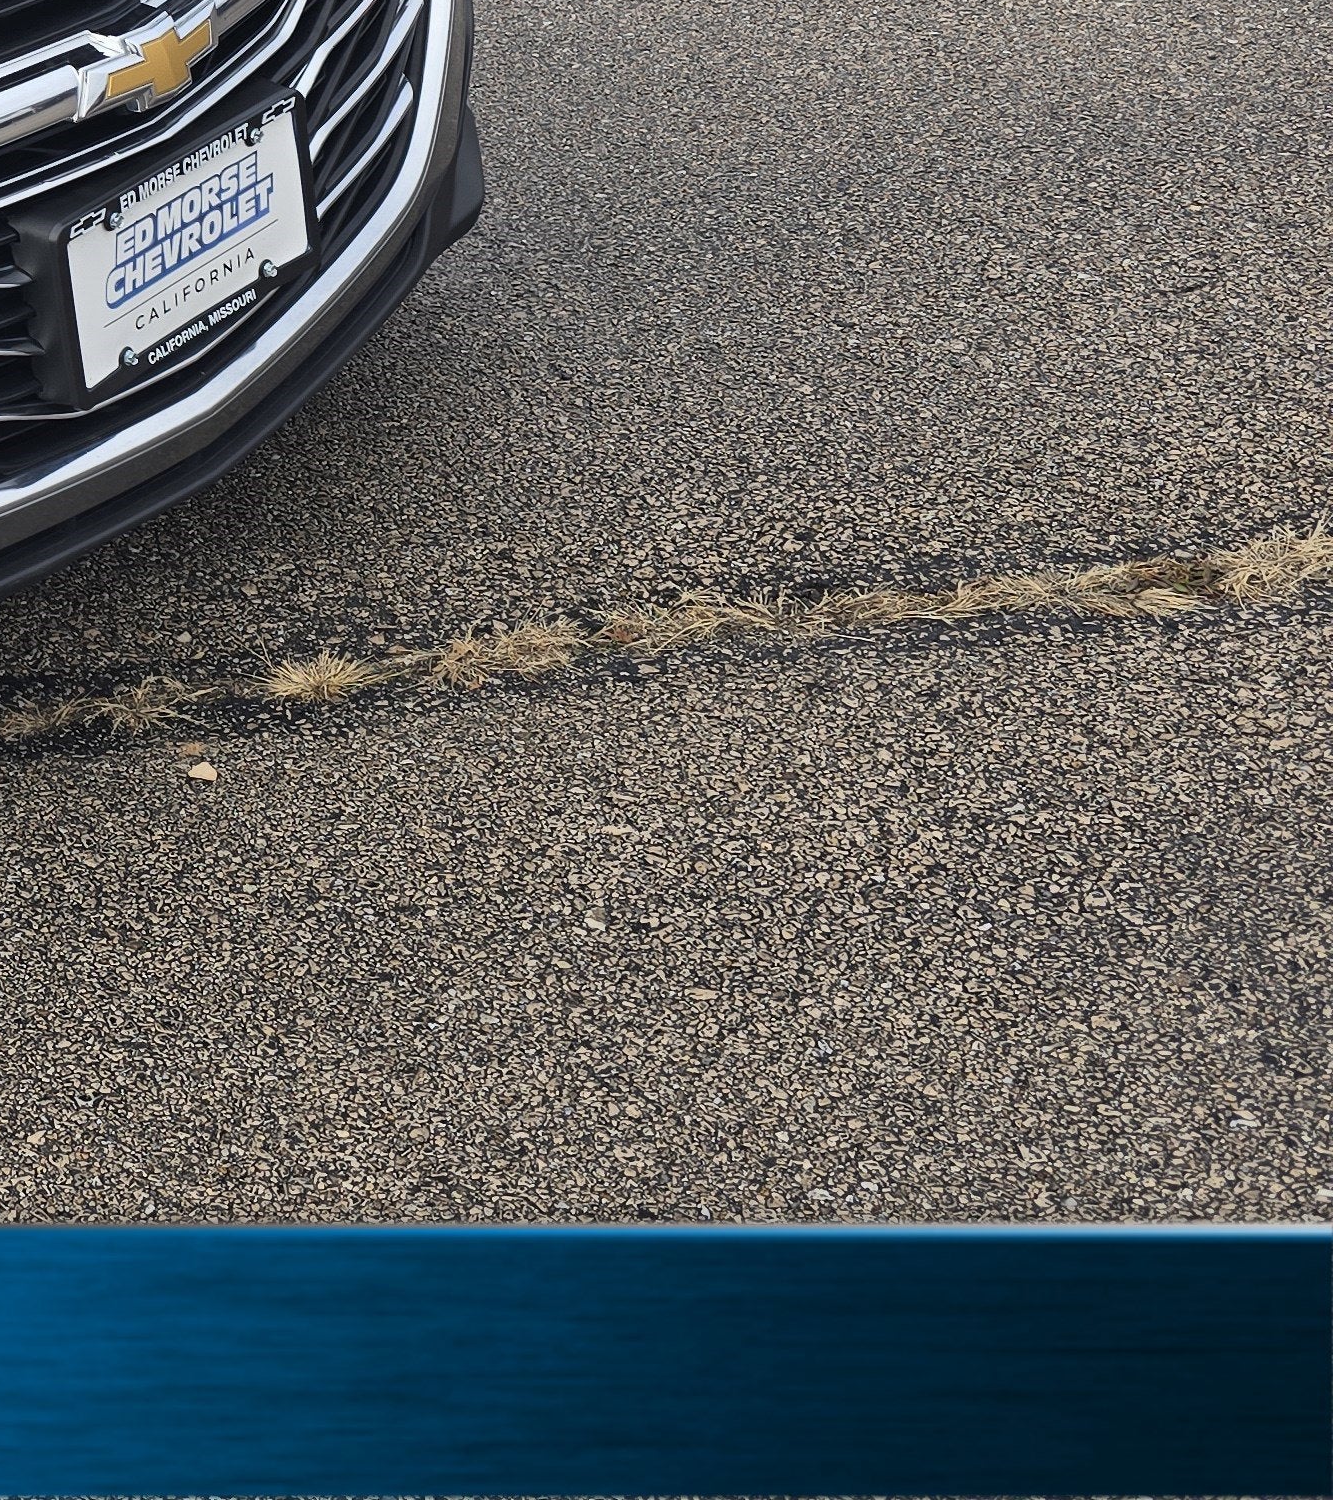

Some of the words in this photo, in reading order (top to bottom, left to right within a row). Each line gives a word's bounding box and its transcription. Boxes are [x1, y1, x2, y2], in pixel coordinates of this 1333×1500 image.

[116, 213, 156, 266] ED
[156, 151, 258, 241] MORSE
[119, 190, 137, 213] ED
[138, 164, 182, 201] MORSE
[183, 123, 250, 174] CHEVROLET
[106, 173, 273, 309] CHEVROLET
[135, 247, 255, 330] CALIFORNIA
[148, 322, 209, 365] CALIFORNIA,
[209, 288, 257, 326] MISSOURI
